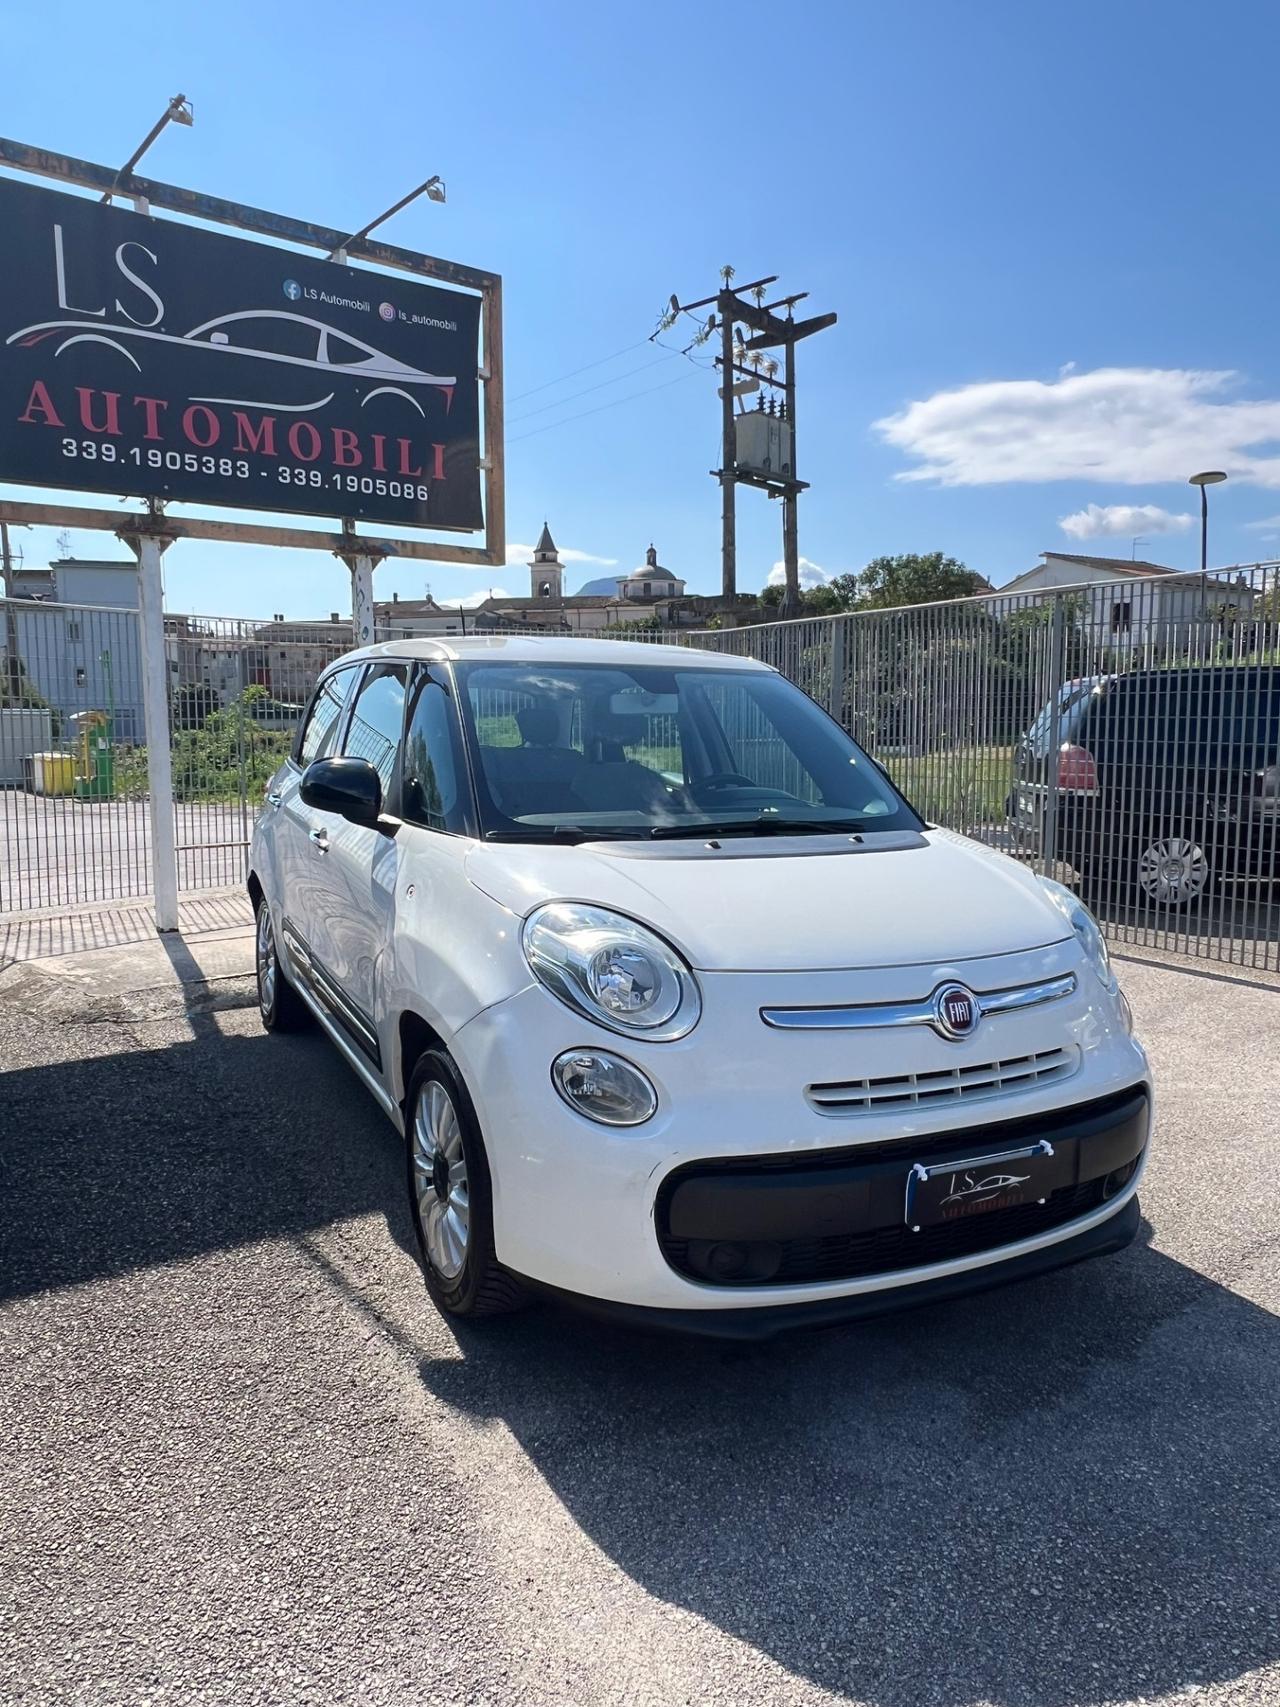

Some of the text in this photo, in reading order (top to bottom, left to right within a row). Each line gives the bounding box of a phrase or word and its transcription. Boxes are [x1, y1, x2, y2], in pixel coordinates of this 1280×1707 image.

[54, 223, 165, 328] LS
[303, 287, 371, 312] LS Automobili
[398, 309, 457, 332] ls_automobili
[17, 380, 447, 480] AUTOMOBILI
[61, 437, 250, 479] 339.1905383
[277, 466, 429, 501] 339.1905086
[949, 1001, 970, 1023] FIAT
